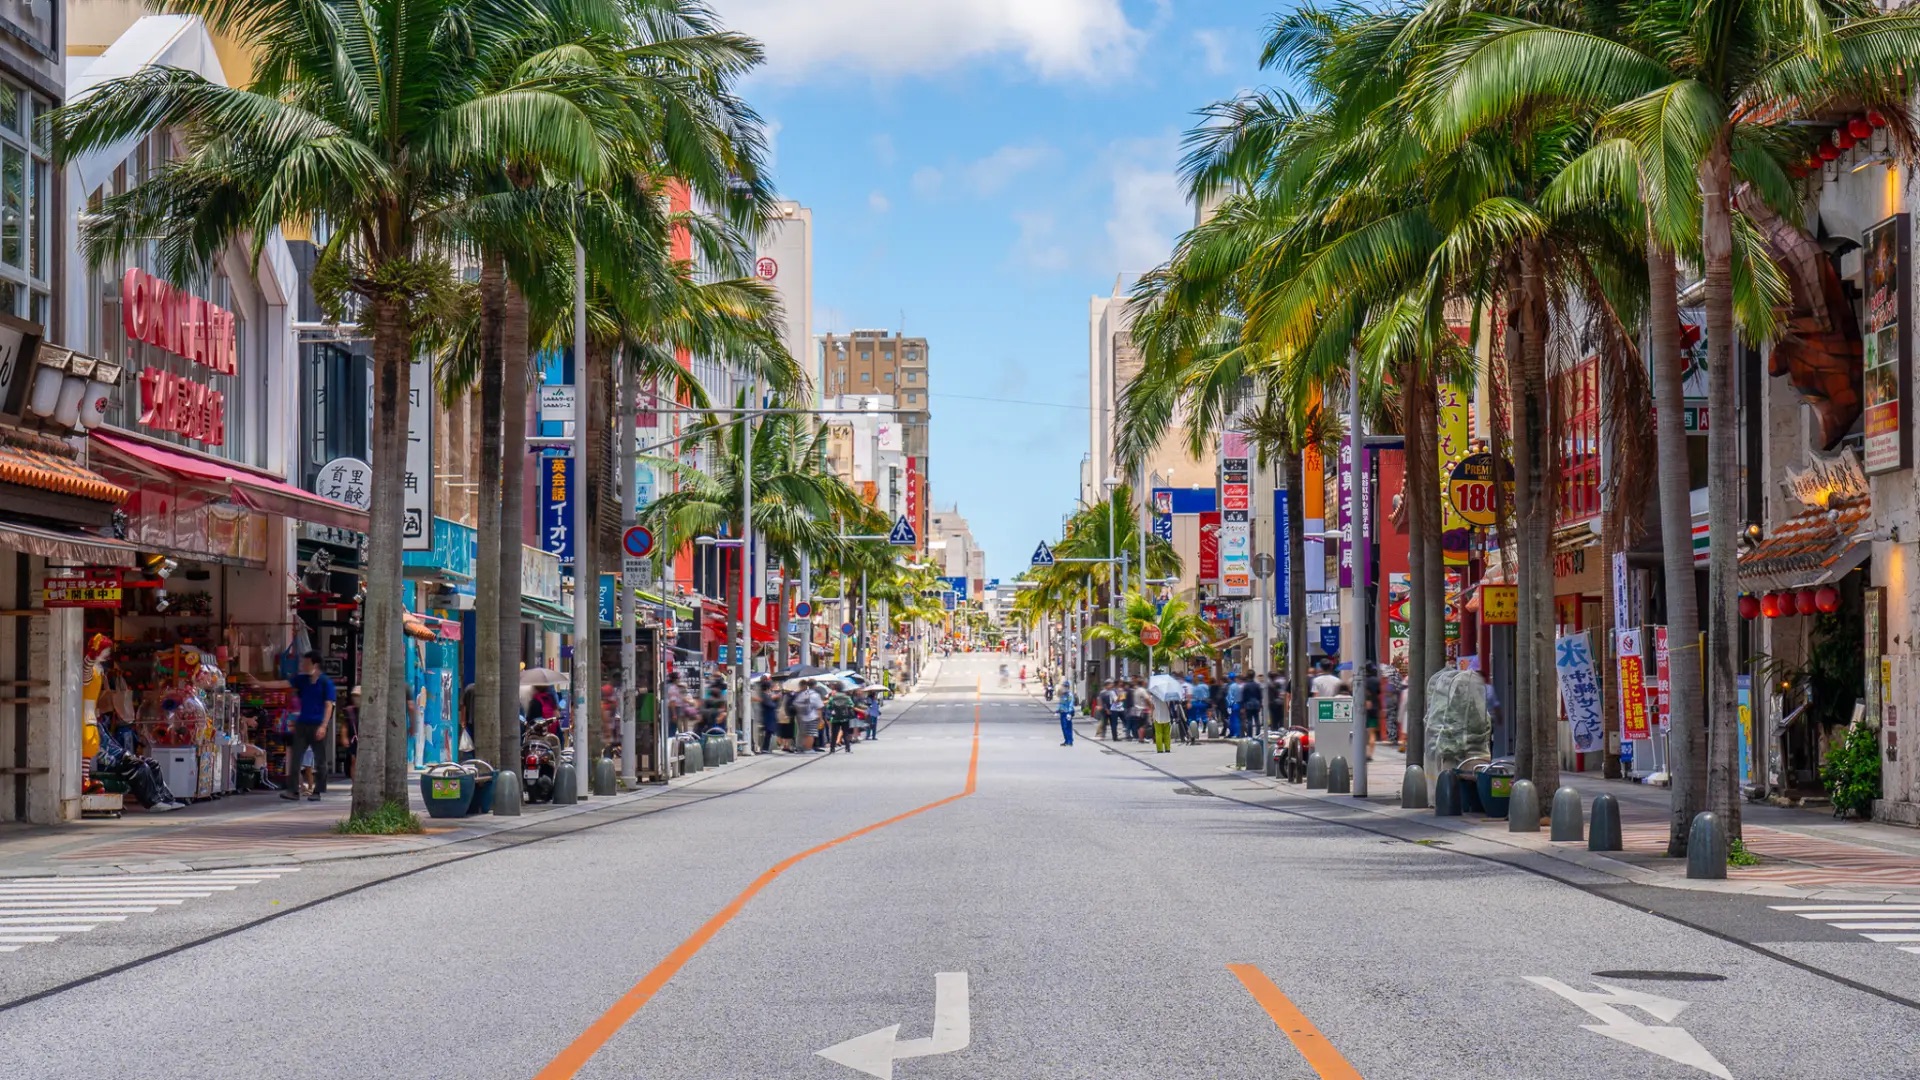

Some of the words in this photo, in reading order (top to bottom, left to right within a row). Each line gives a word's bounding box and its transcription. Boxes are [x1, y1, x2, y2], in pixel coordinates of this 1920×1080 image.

[758, 262, 773, 277] 福
[331, 465, 364, 485] 首里
[551, 459, 567, 502] 英会話
[1465, 463, 1493, 475] PREMI
[907, 467, 916, 530] ハイサイお
[550, 501, 567, 554] イーオン
